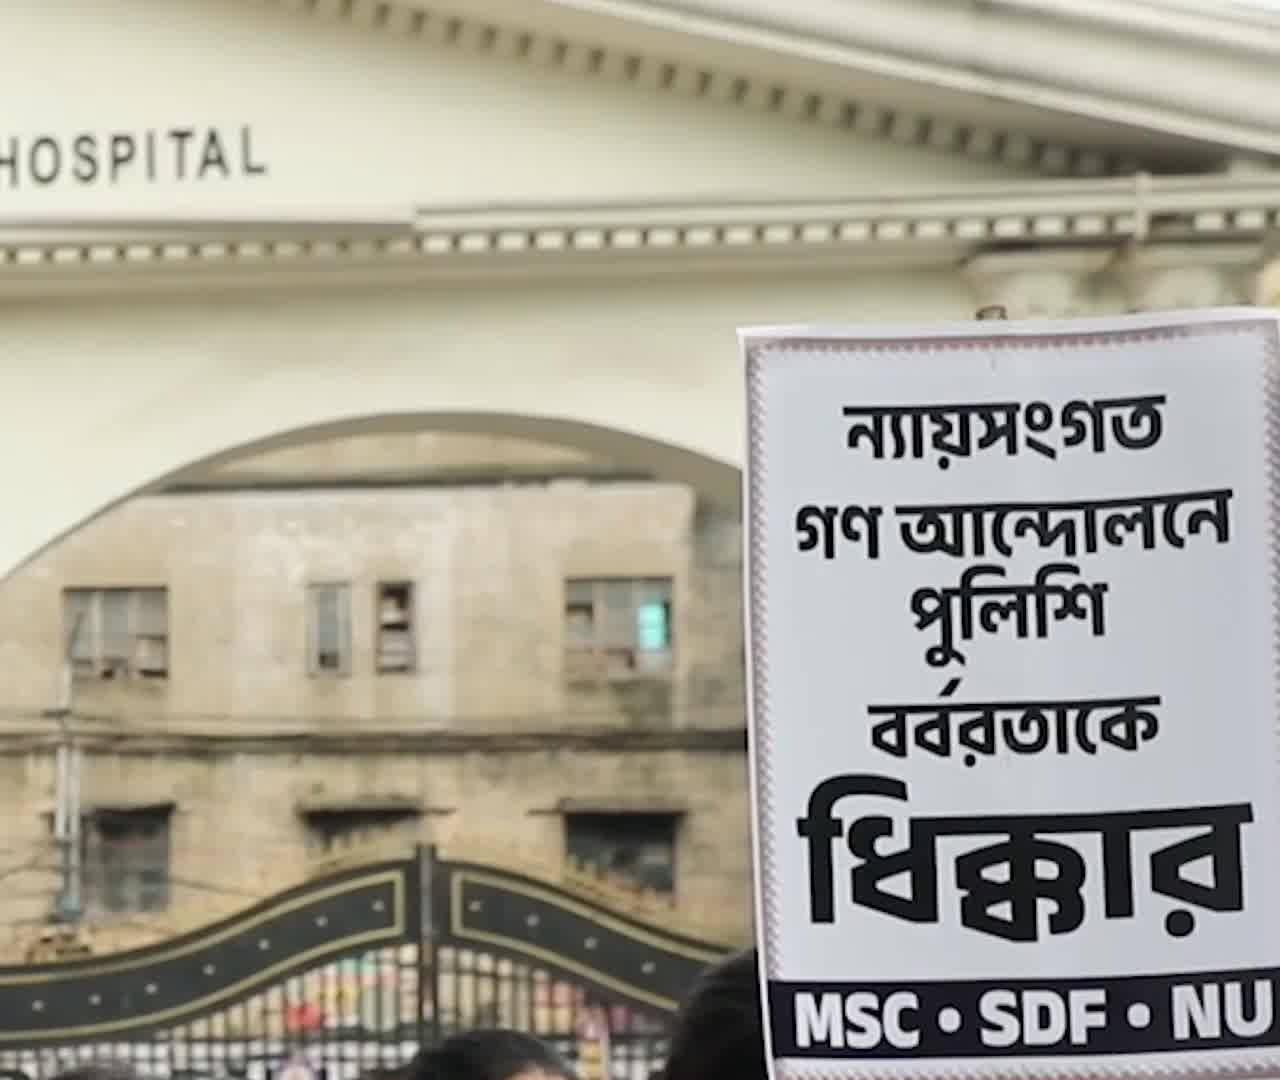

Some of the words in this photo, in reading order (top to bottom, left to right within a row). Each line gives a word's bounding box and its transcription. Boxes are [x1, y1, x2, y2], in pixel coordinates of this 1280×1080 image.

[843, 395, 1166, 470] ন্যায়সংগত
[796, 506, 883, 559] গণ
[895, 489, 1233, 557] আন্দোলনে
[911, 563, 1108, 667] পুলিশি
[868, 678, 1160, 767] বর্বরতাকে
[797, 774, 1253, 942] ধিক্কার
[793, 990, 922, 1050] MSC
[978, 988, 1108, 1048] SDF
[1170, 978, 1275, 1041] NU
